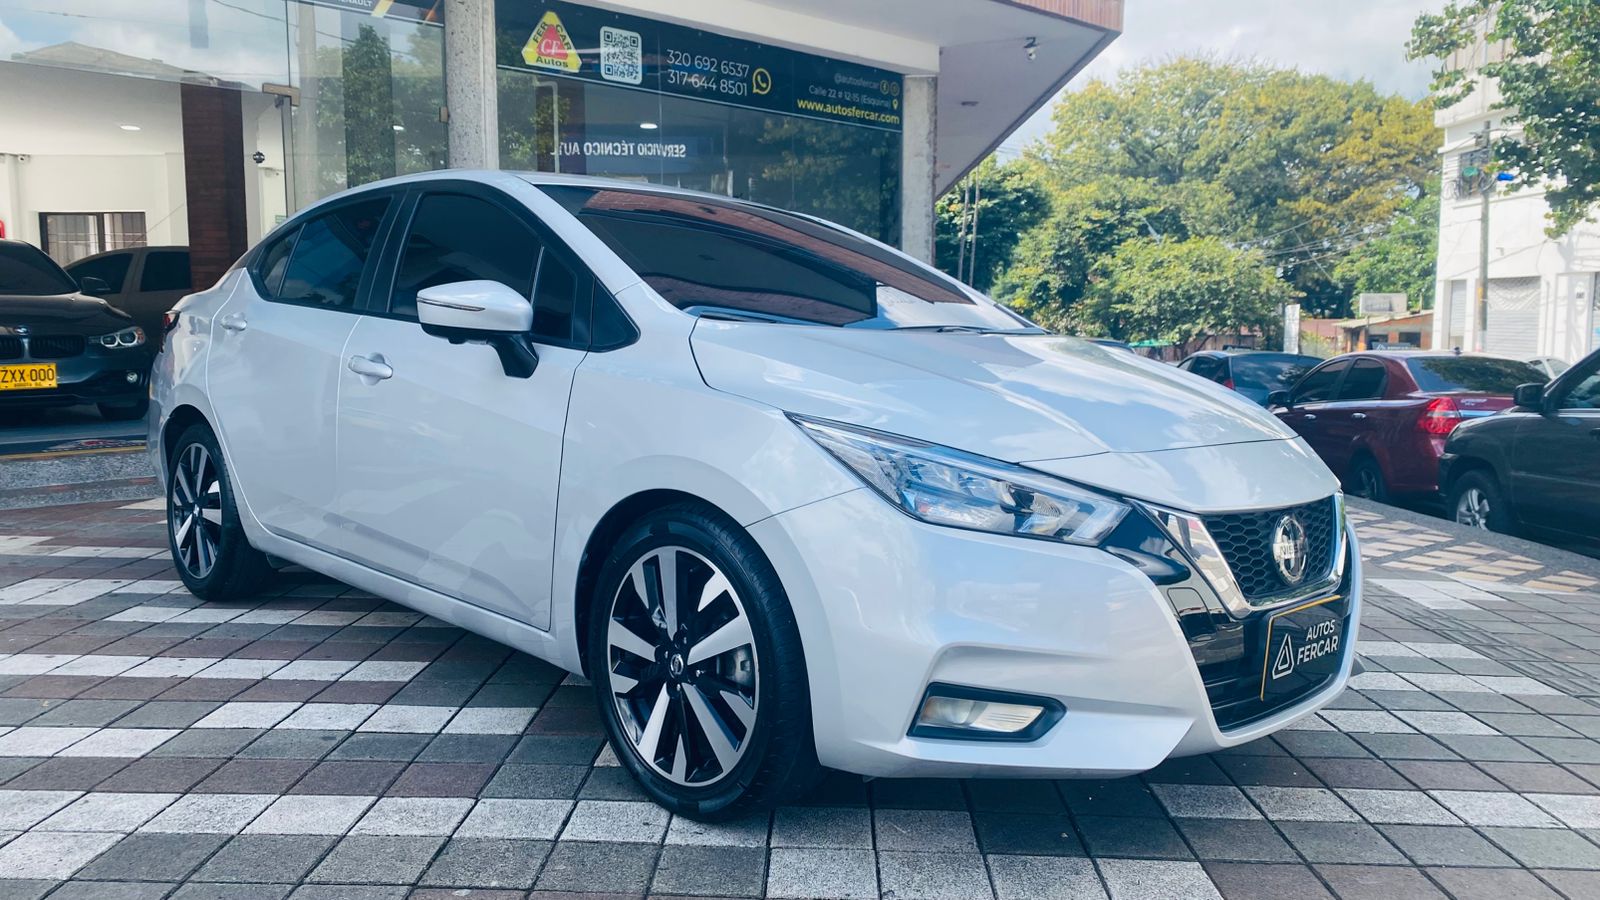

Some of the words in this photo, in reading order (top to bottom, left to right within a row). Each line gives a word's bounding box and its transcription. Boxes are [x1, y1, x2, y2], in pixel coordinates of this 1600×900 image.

[532, 21, 549, 44] FER
[555, 23, 572, 50] CAR
[536, 55, 569, 68] Autos
[666, 49, 691, 67] 320
[694, 55, 718, 72] 692
[721, 61, 749, 78] 6537
[667, 69, 689, 85] 317
[691, 73, 717, 91] 644
[720, 79, 748, 96] 8501
[827, 88, 837, 98] 22
[797, 99, 900, 124] www.autosfercar.com
[0, 369, 26, 383] ZXX
[30, 368, 54, 381] 000
[1306, 619, 1336, 641] AUTOS
[1297, 635, 1339, 665] FERCAR
